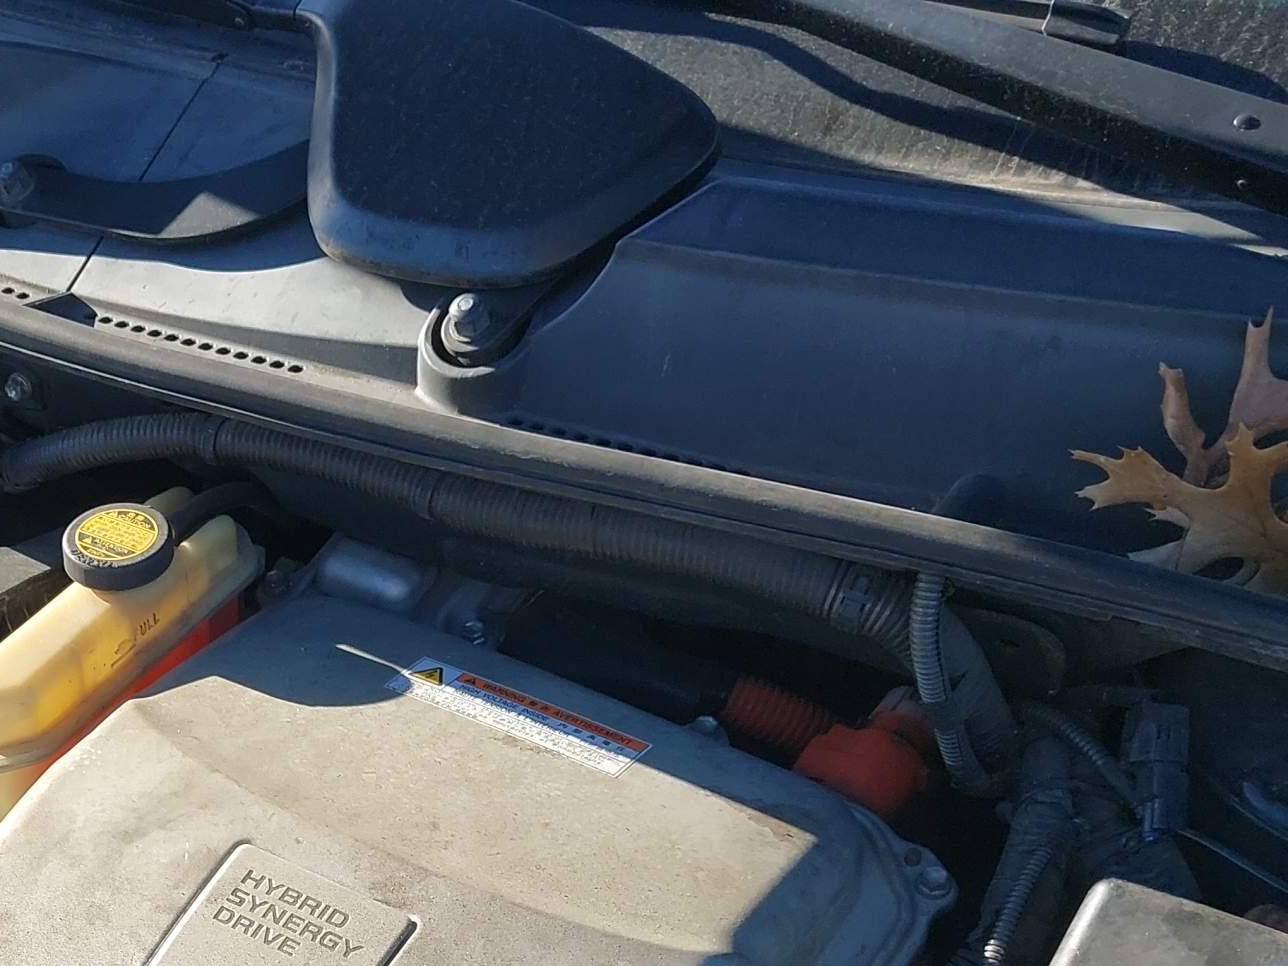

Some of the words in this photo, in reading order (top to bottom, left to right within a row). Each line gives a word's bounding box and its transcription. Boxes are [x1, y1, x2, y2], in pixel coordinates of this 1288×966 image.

[483, 693, 519, 709] VOLTAGE
[226, 887, 365, 958] SYNERGY
[240, 869, 350, 929] HYBRID
[213, 905, 301, 957] DRIVE
